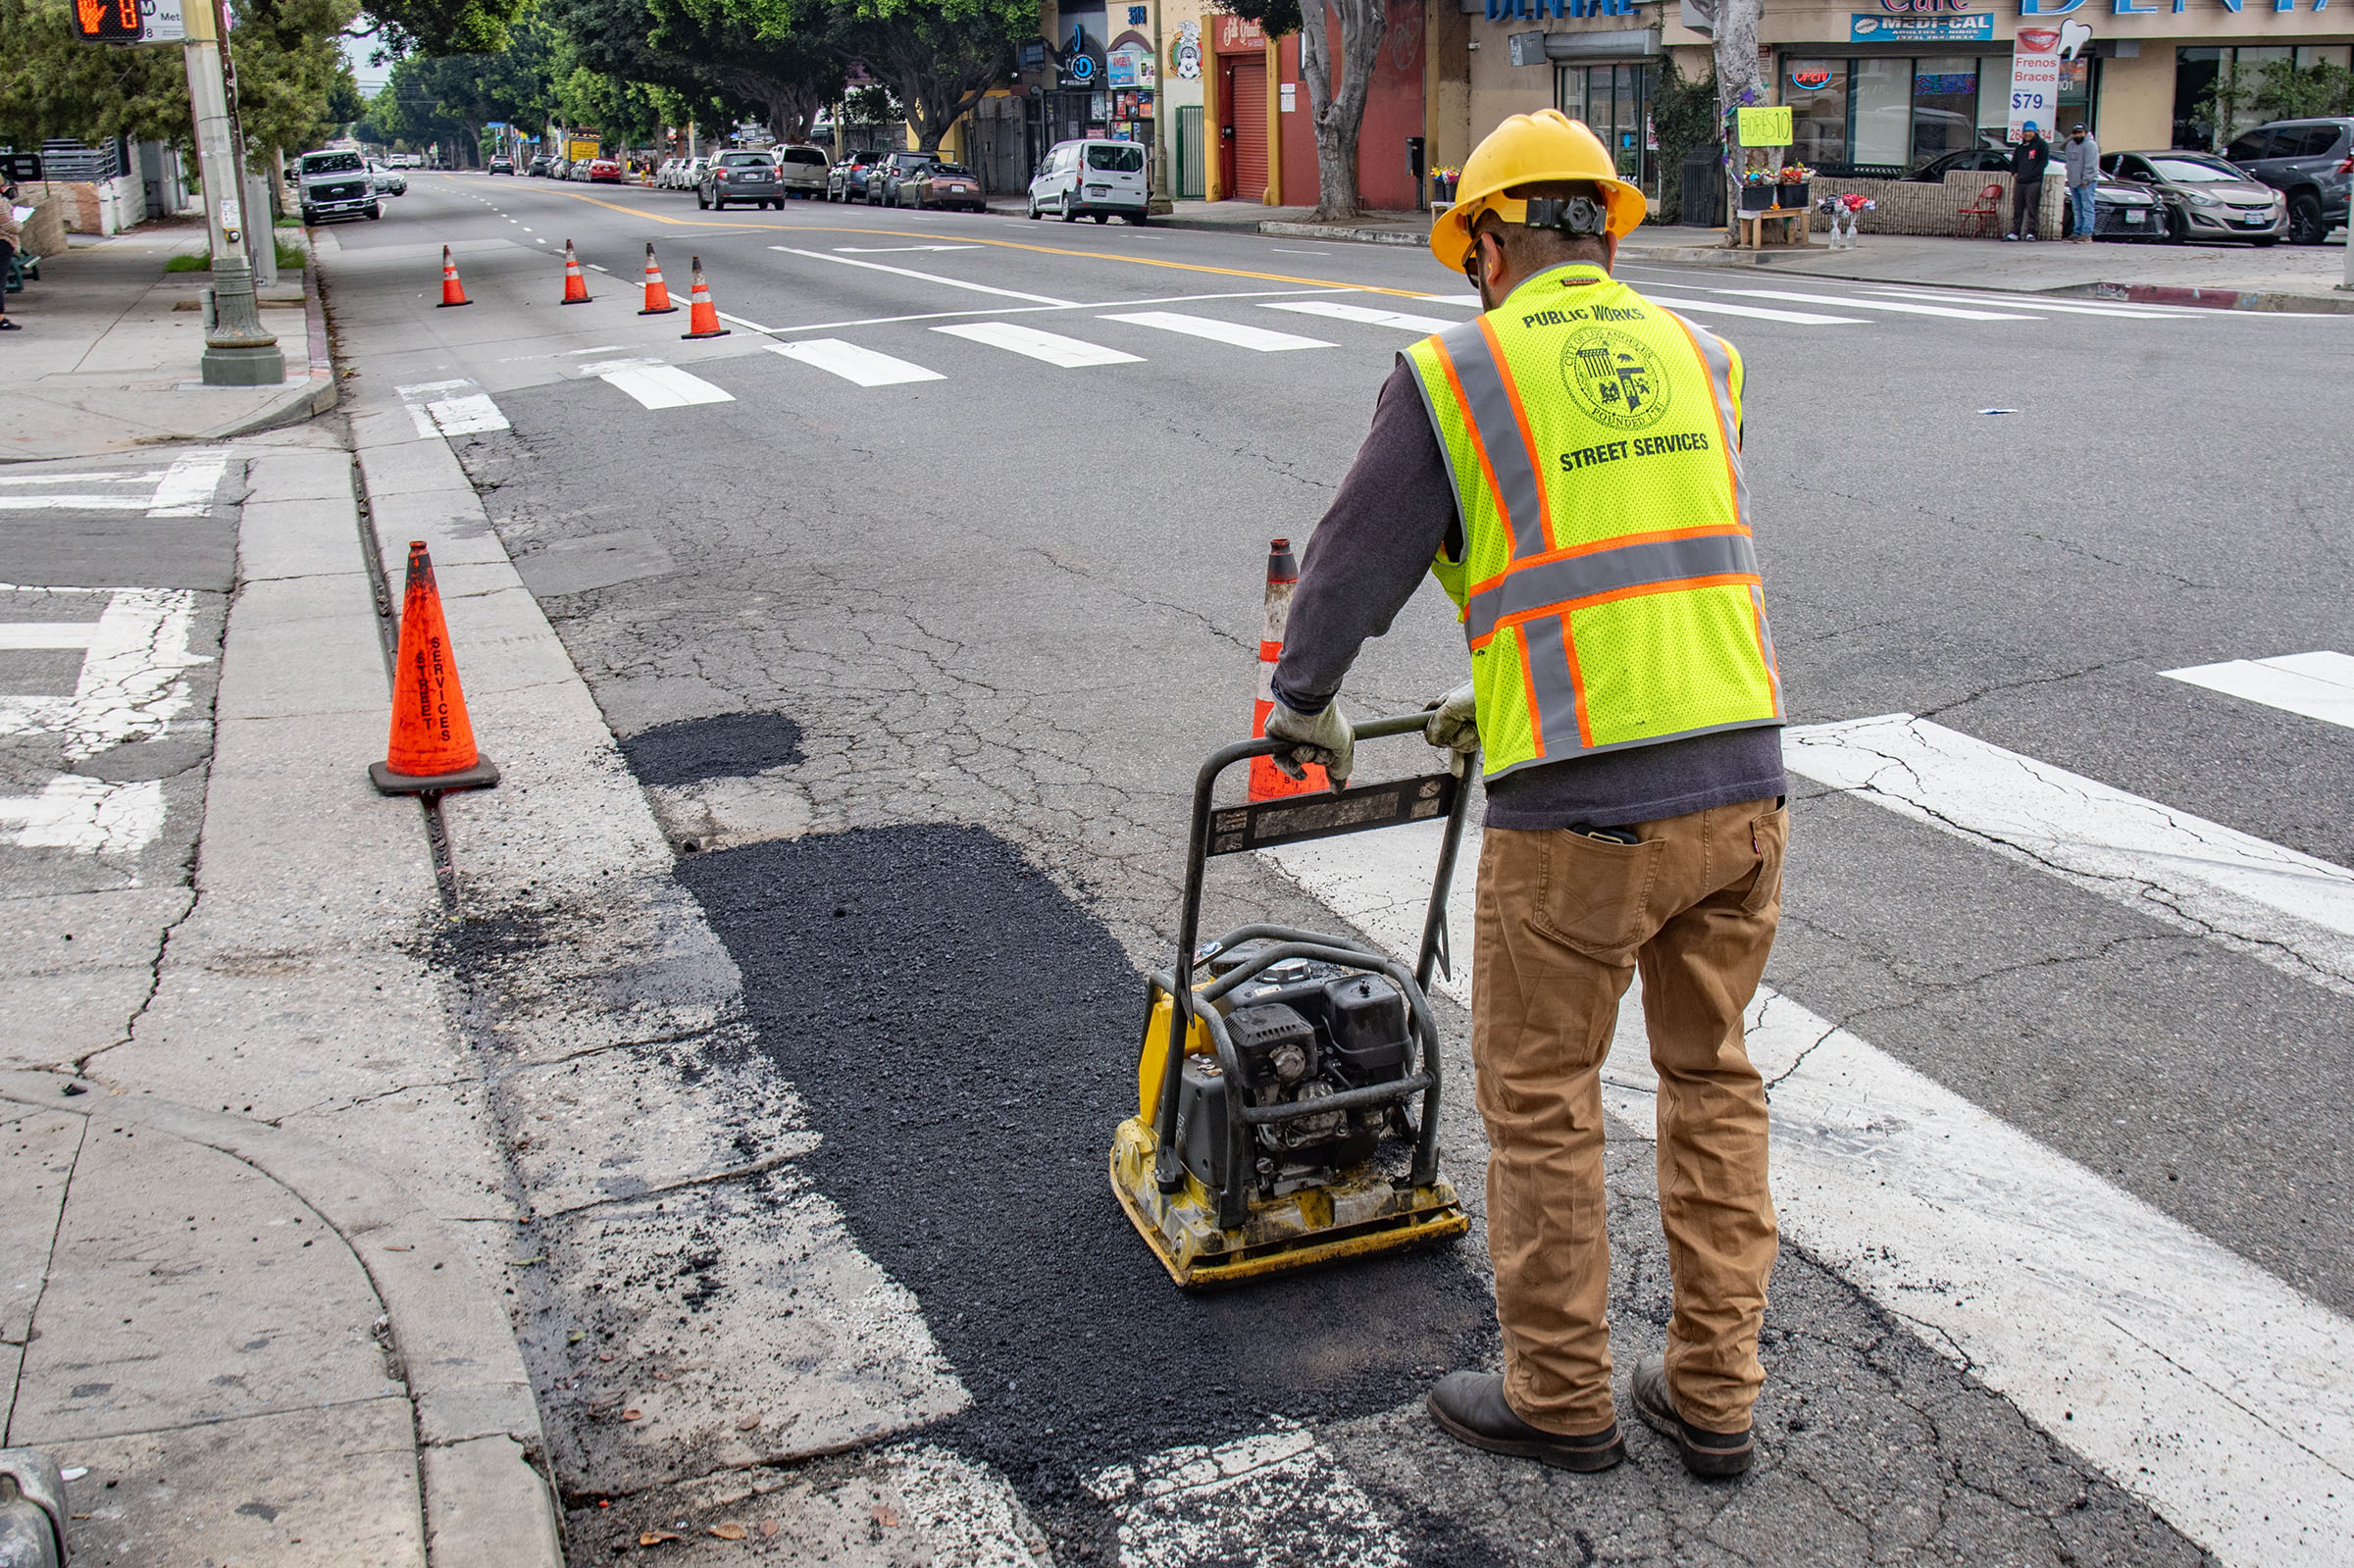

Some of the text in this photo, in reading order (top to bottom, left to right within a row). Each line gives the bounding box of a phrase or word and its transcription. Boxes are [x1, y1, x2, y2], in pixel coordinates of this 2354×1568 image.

[1881, 17, 1990, 29] MEDI-CAL
[2016, 57, 2057, 68] Frenos
[2015, 72, 2056, 81] Braces
[2012, 93, 2043, 110] $79
[1741, 111, 1790, 139] FLORES 10
[1522, 305, 1646, 329] PUBLIC WORKS
[1564, 344, 1578, 367] CITY
[1573, 334, 1585, 344] OF
[1592, 408, 1646, 428] FOUNDED
[1560, 432, 1709, 472] STREET SERVICES
[416, 652, 433, 730] STREET
[431, 637, 451, 741] SERVICES
